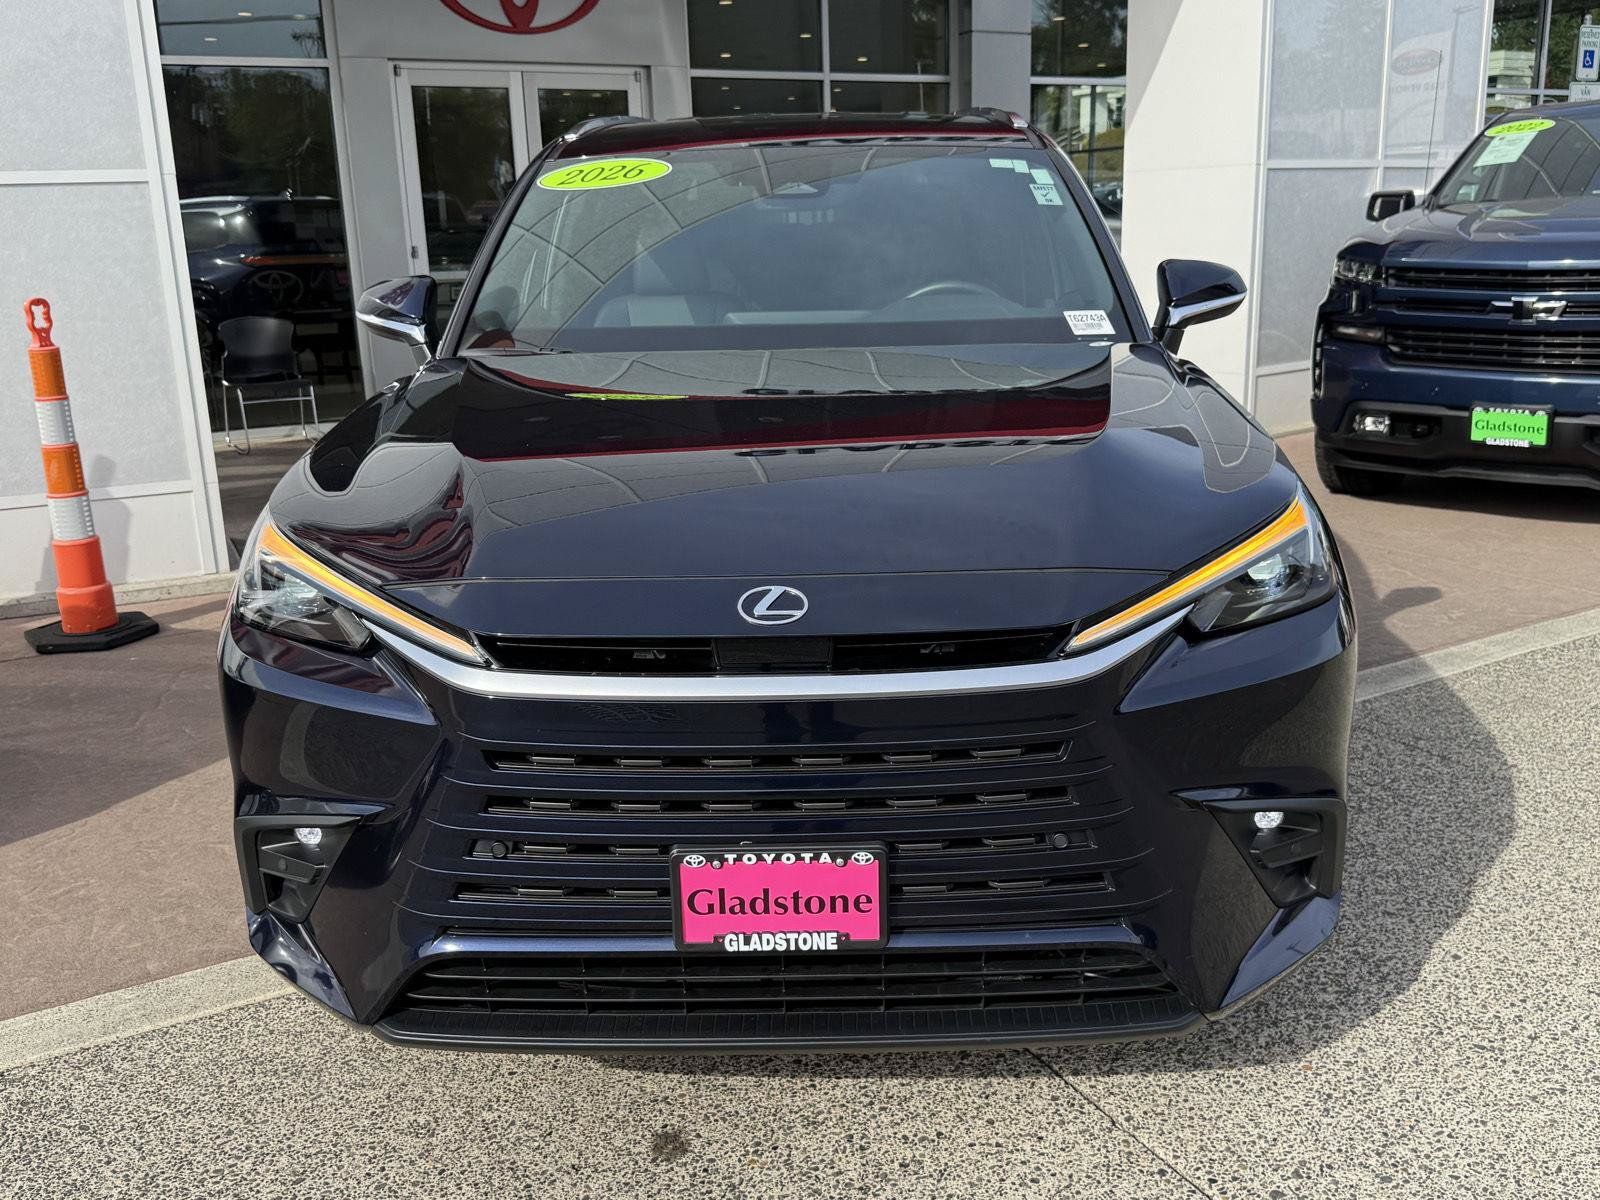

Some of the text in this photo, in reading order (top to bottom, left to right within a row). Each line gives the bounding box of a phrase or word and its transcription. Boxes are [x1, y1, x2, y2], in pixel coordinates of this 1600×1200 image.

[1580, 88, 1591, 96] VAN
[557, 162, 653, 186] 2026
[1067, 313, 1107, 323] T62743A
[1488, 407, 1530, 416] TOYOTA
[1474, 419, 1544, 434] Gladstone
[1485, 437, 1530, 447] GLADSTONE
[724, 852, 833, 865] TOYOTA
[687, 887, 873, 916] Gladstone
[724, 932, 838, 952] GLADSTONE
